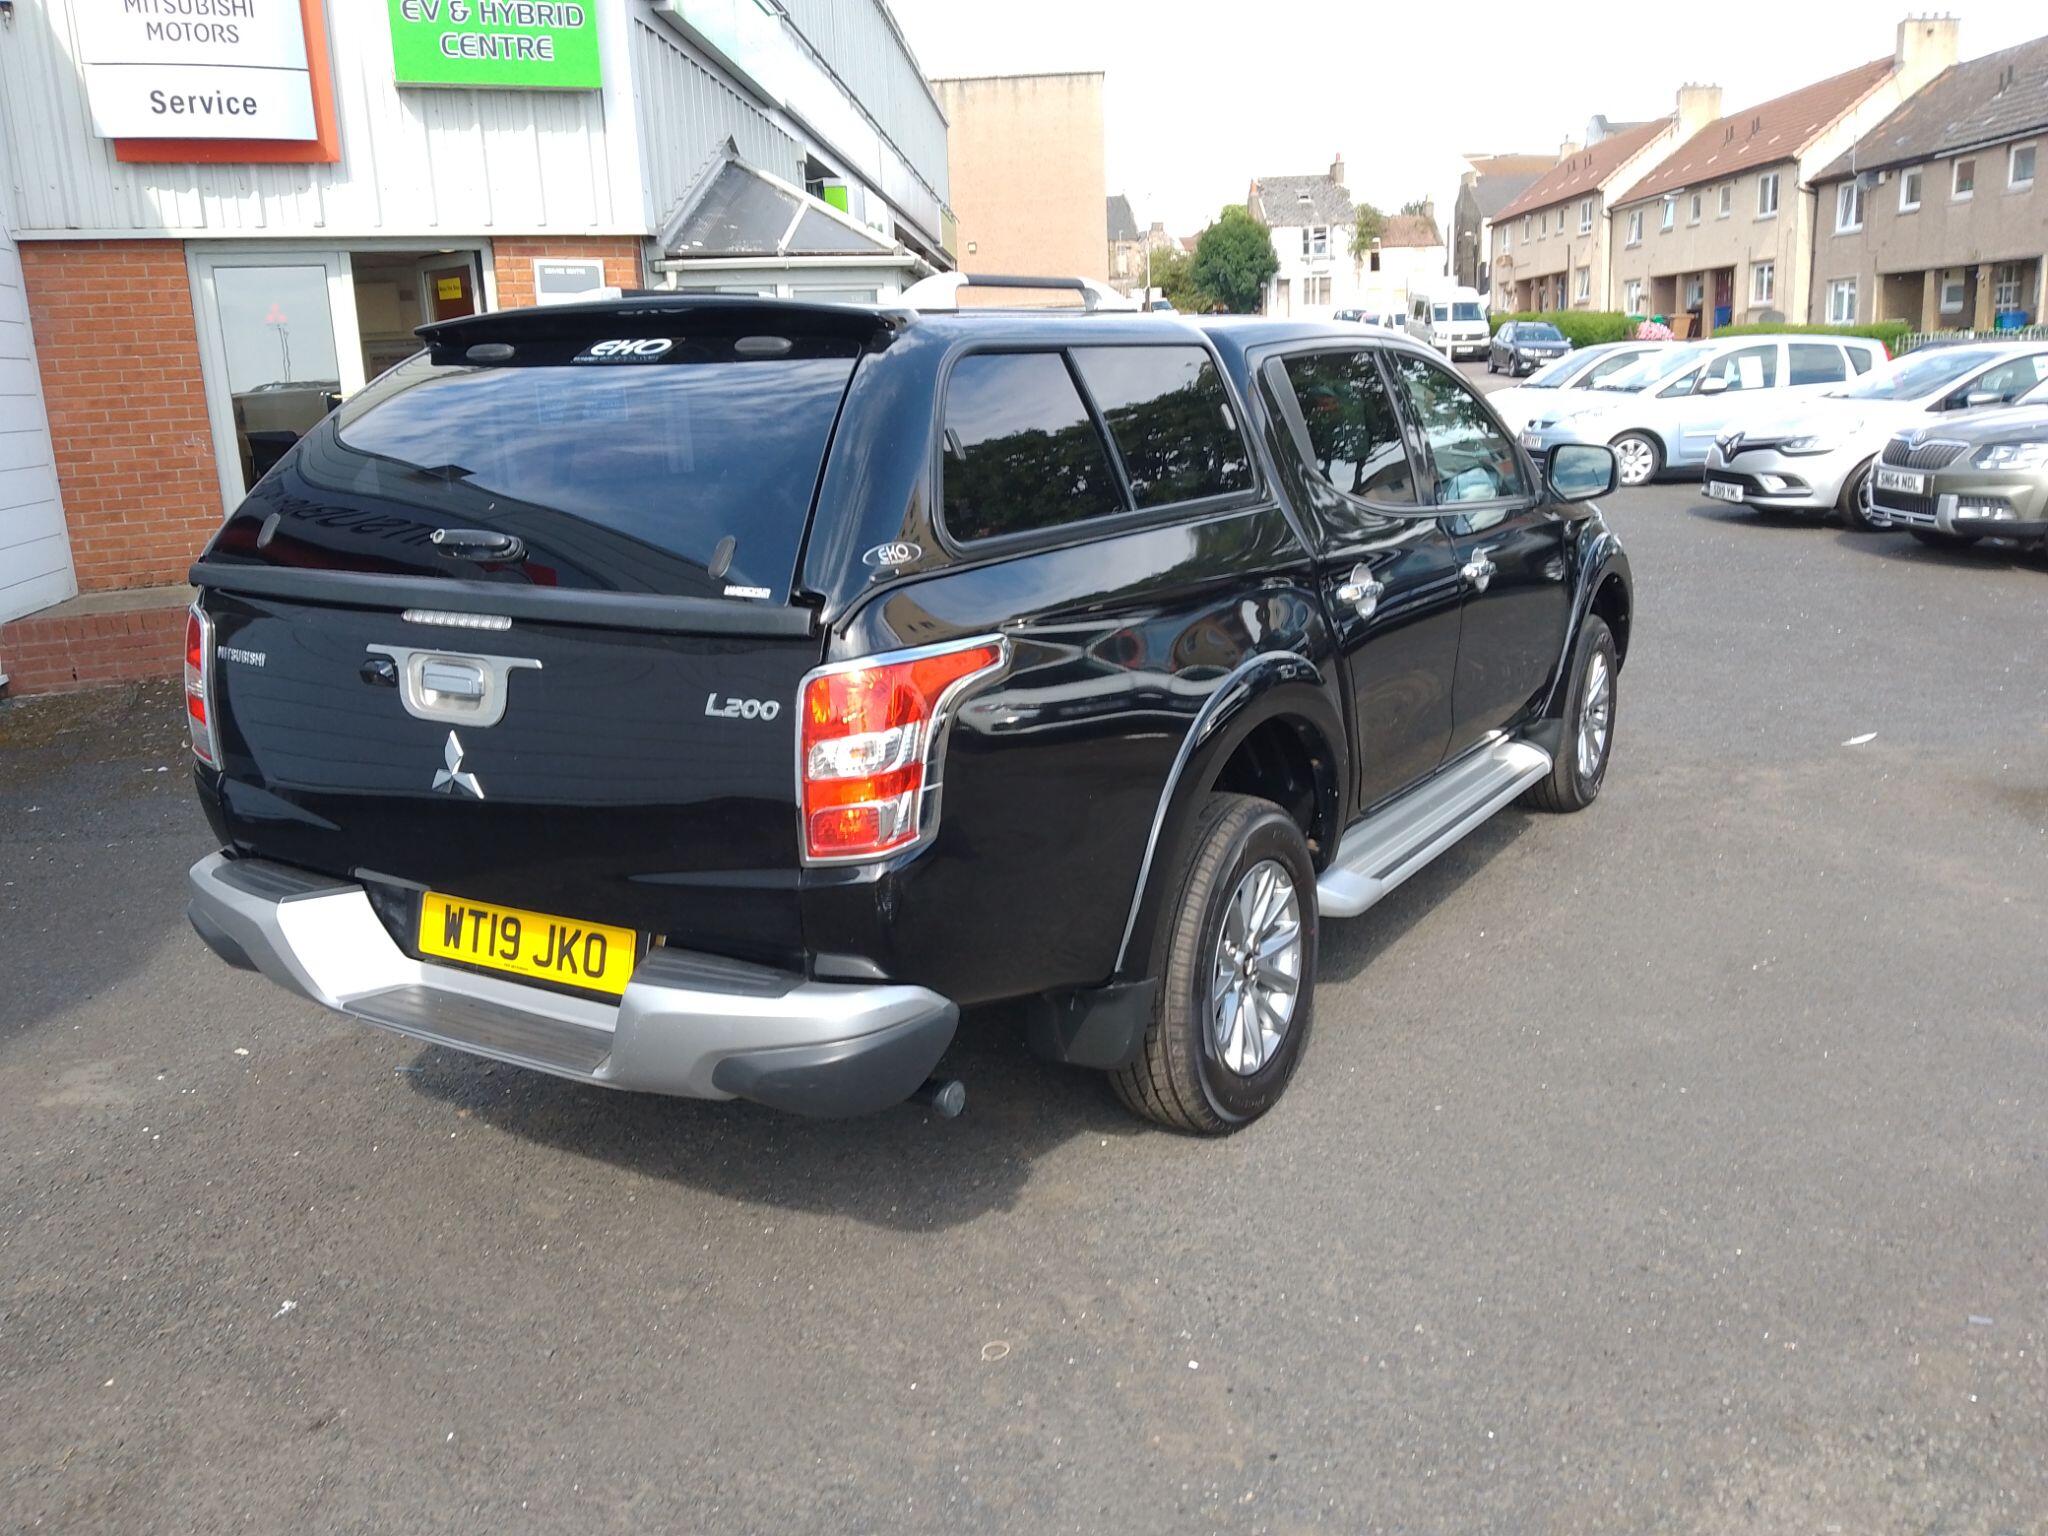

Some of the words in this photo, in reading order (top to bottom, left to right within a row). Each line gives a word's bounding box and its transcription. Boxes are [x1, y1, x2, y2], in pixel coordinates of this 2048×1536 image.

[402, 0, 440, 20] EV
[450, 0, 469, 22] &
[479, 1, 584, 27] HYBRID
[146, 21, 240, 43] MOTORS
[441, 34, 553, 58] CENTRE
[150, 89, 257, 115] Service
[590, 338, 672, 356] EKO
[217, 645, 266, 667] MITSUBISHI
[705, 692, 780, 721] L200
[443, 903, 522, 961] WT19
[532, 924, 607, 979] JKO
